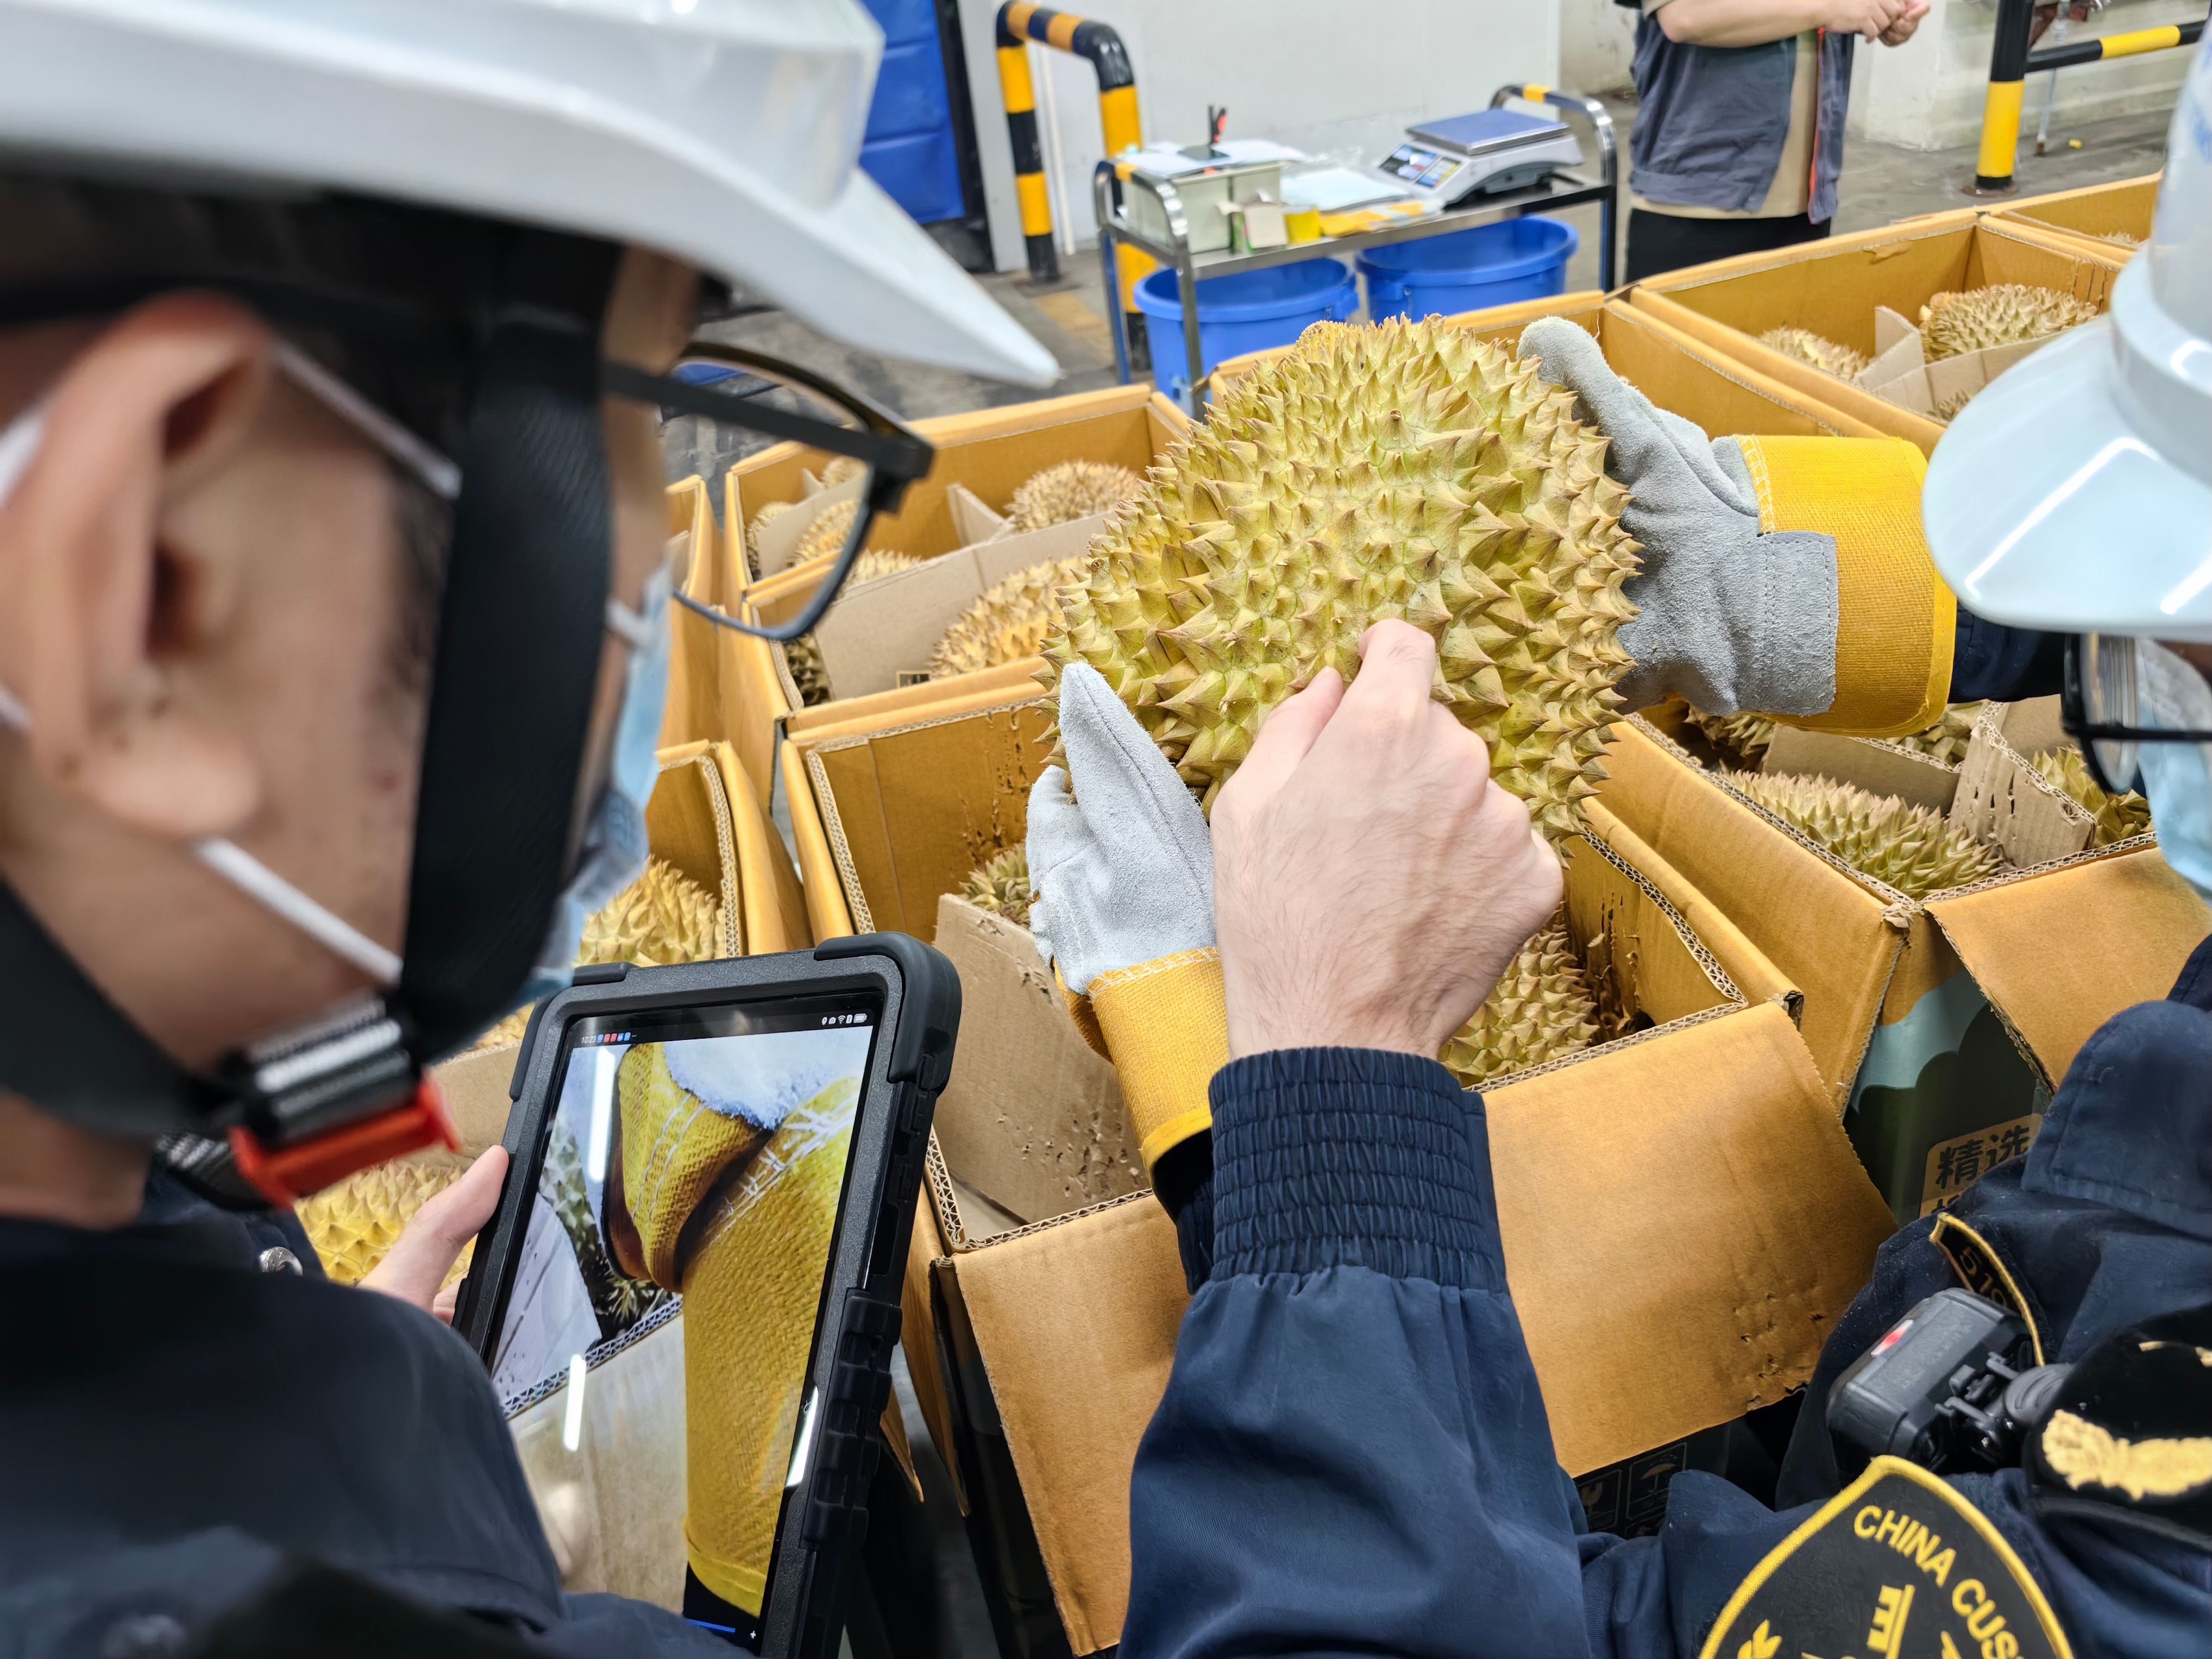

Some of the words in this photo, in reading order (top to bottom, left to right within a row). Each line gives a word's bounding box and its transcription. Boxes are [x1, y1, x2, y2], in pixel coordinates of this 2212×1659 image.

[581, 1035, 597, 1044] 10:23
[1936, 1125, 2030, 1189] 精选
[1854, 1506, 1956, 1588] CHINA
[1952, 1578, 2026, 1659] CUS
